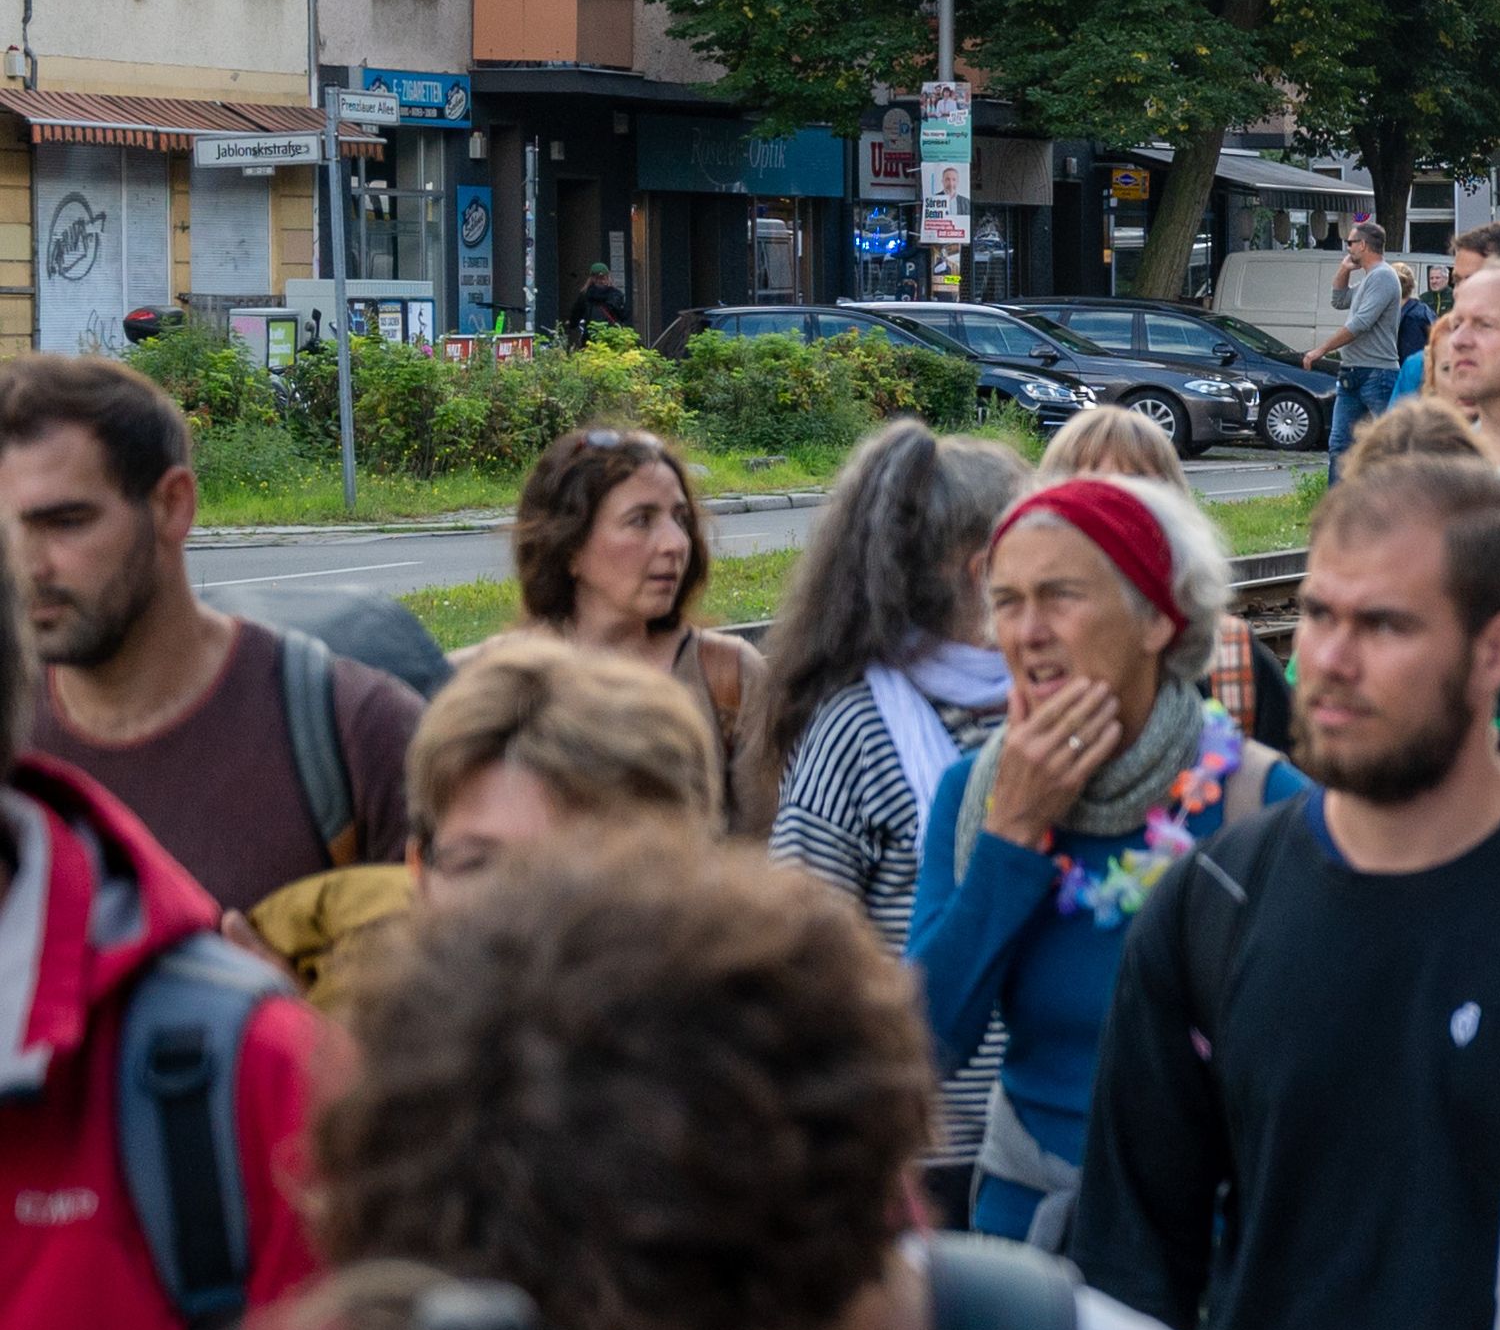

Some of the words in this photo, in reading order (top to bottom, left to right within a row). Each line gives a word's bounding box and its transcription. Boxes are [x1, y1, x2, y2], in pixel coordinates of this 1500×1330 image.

[393, 79, 442, 104] E-ZIGARETTEN
[341, 97, 376, 115] Prenzlauer
[377, 100, 395, 116] Allee
[925, 197, 948, 208] Sören
[925, 207, 944, 219] Benn
